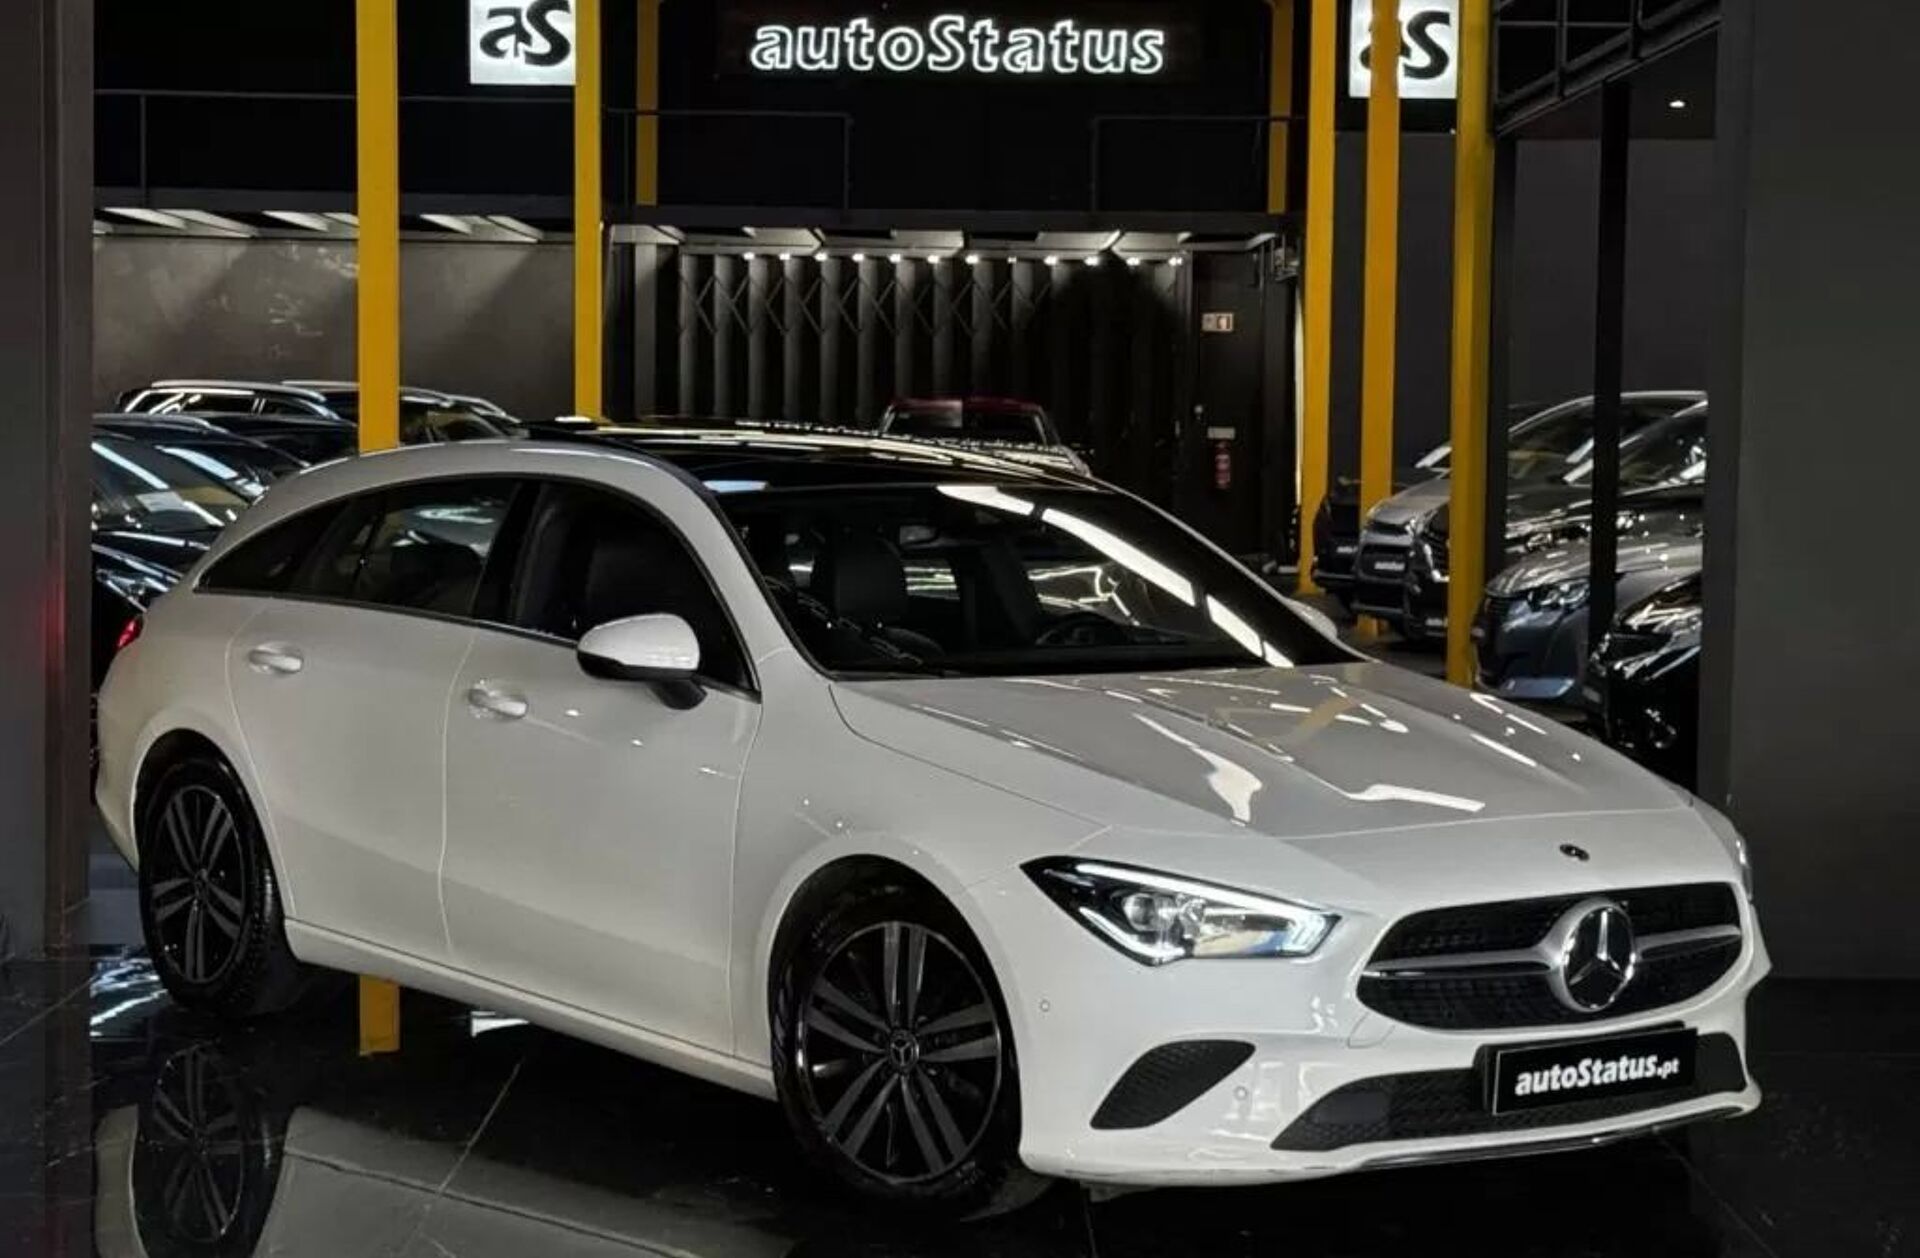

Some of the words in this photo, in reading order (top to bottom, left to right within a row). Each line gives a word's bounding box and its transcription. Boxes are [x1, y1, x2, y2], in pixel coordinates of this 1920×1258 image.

[480, 0, 571, 67] aS
[750, 15, 1164, 74] autoStatus
[1359, 10, 1451, 79] S
[1515, 1055, 1680, 1096] autoStatus.pt
